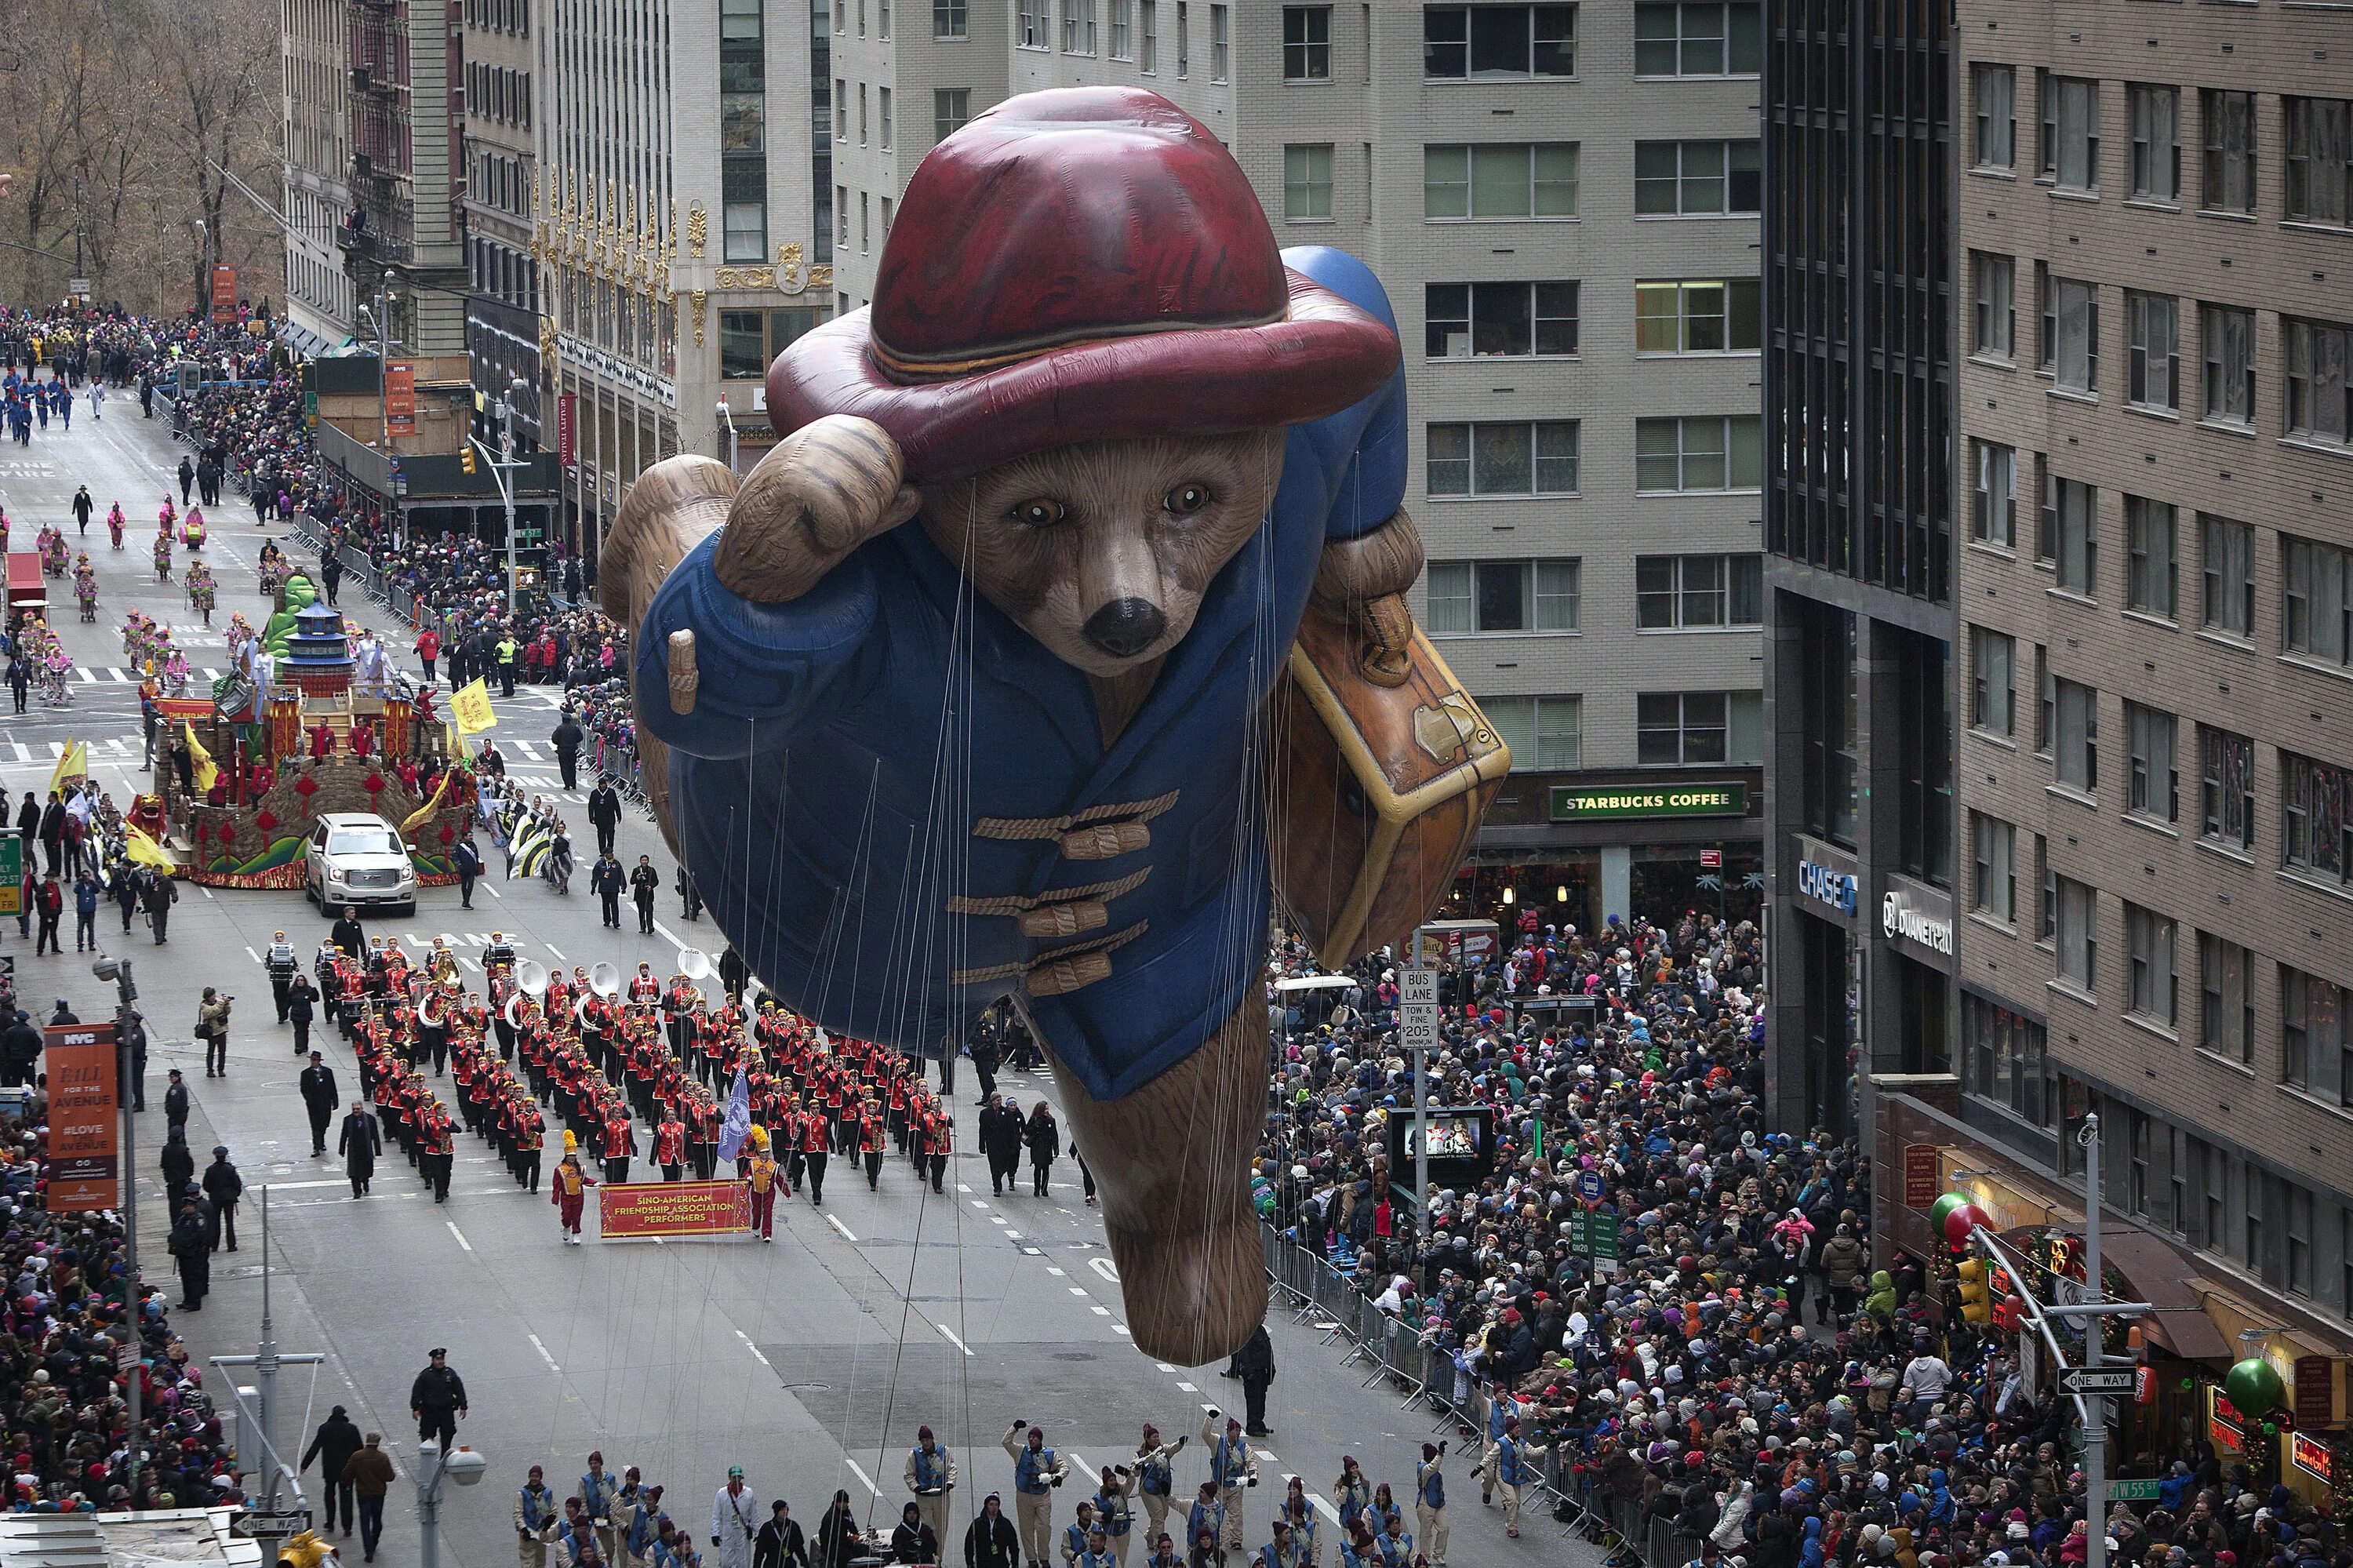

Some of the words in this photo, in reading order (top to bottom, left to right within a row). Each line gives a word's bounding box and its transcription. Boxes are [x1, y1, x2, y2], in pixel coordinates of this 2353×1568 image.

[533, 792, 590, 804] BU
[1566, 795, 1664, 810] STARBUCKS
[1669, 793, 1729, 806] COFFEE
[1799, 860, 1844, 910] CHASE
[1899, 908, 1952, 956] DUANEread
[1409, 974, 1429, 985] BUS
[1406, 989, 1432, 1000] LANE
[64, 1033, 95, 1045] NYC
[54, 1095, 111, 1108] AVENUE
[63, 1124, 104, 1136] #LOVE
[59, 1141, 107, 1151] AVENUE
[637, 1195, 711, 1205] SINO-AMERICAN
[614, 1206, 670, 1215] FRIENDSHIP
[672, 1202, 735, 1213] ASSOCIATION
[644, 1213, 706, 1224] PERFORMERS
[1572, 1211, 1584, 1220] QM2
[1572, 1222, 1584, 1231] QM3
[1572, 1244, 1588, 1253] QM20
[2070, 1376, 2093, 1387] ONE
[2103, 1375, 2126, 1385] WAY
[2211, 1421, 2239, 1450] SEATING
[2119, 1483, 2129, 1497] W
[2131, 1483, 2144, 1497] 55
[242, 1520, 265, 1530] ONE
[276, 1519, 296, 1530] WA
